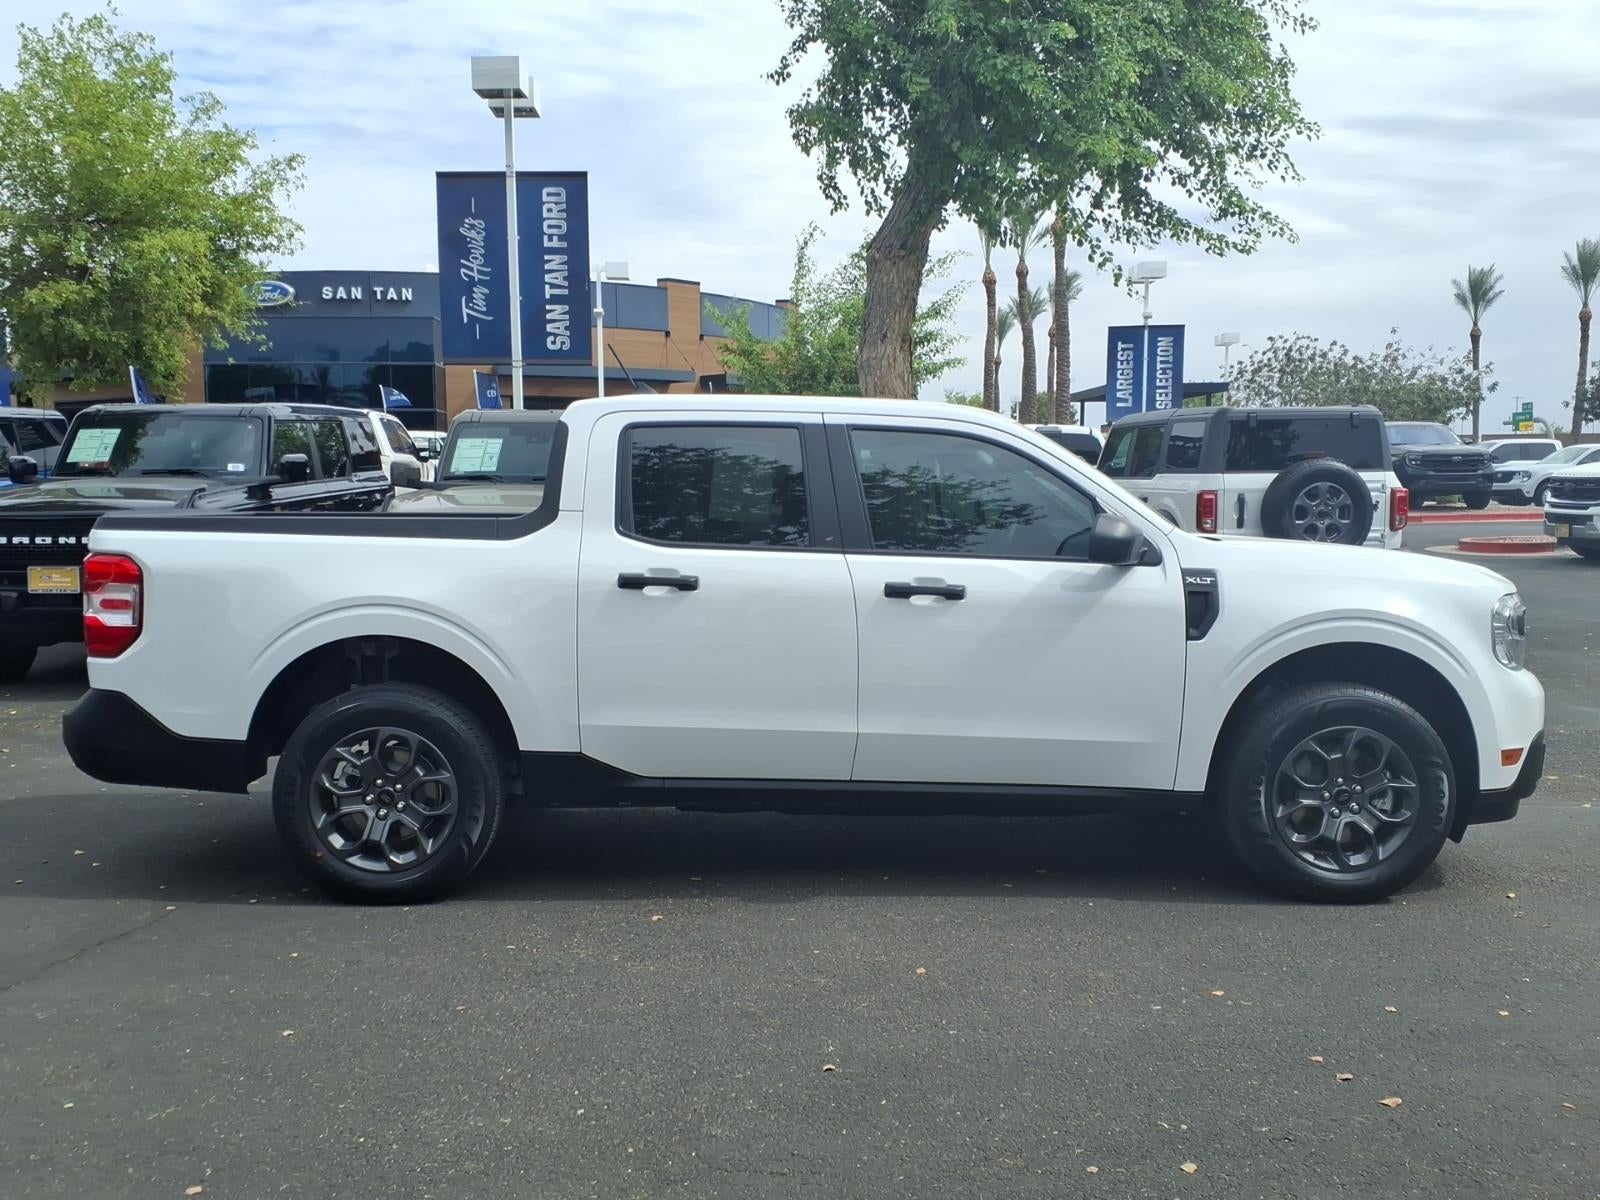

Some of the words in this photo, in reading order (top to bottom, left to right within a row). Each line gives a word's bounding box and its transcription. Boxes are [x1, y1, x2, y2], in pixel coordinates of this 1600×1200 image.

[542, 186, 567, 248] FORD
[459, 216, 492, 283] Hovik's
[321, 286, 363, 300] SAN
[373, 287, 413, 301] TAN
[544, 254, 569, 299] TAN
[461, 286, 495, 325] Tim
[545, 304, 571, 351] SAN
[1116, 341, 1134, 407] LARGEST
[1155, 336, 1174, 409] SELECTION
[1185, 576, 1215, 584] XLT
